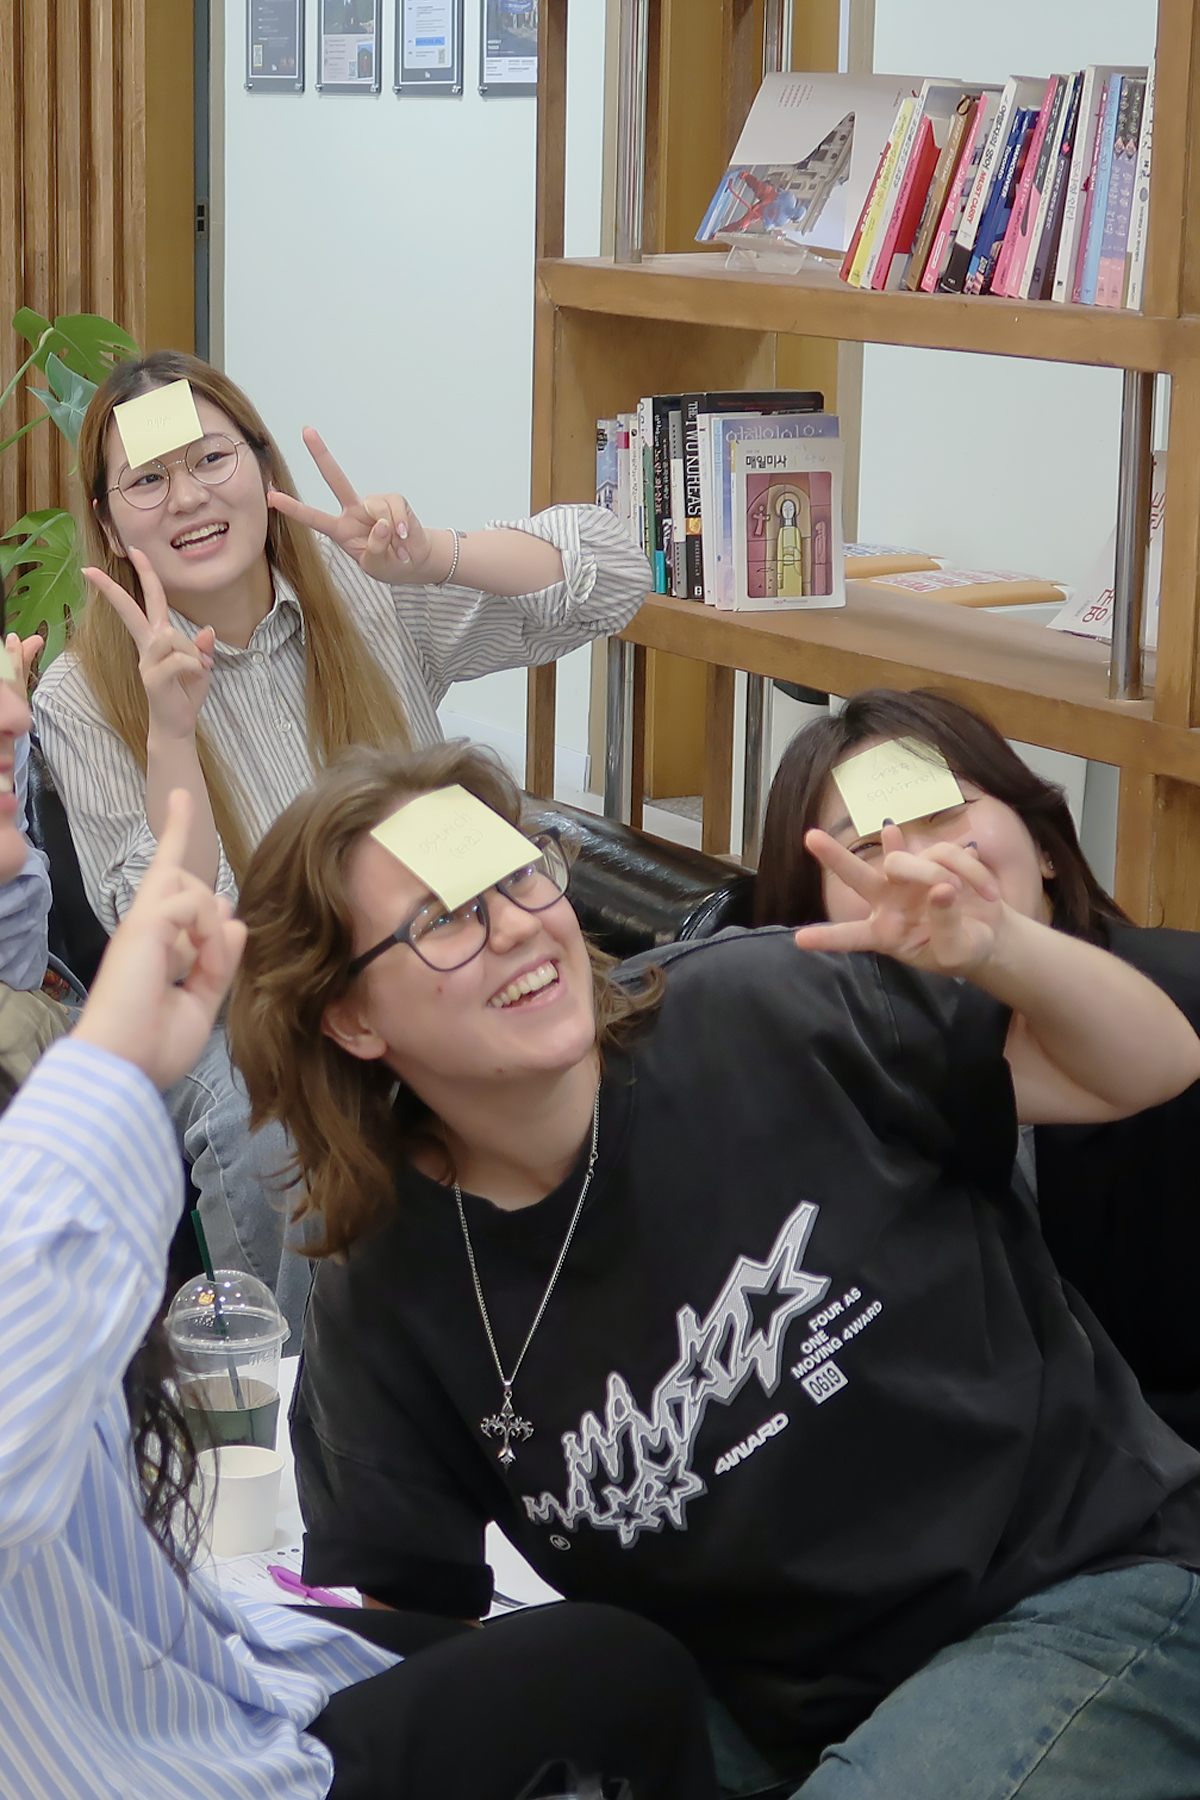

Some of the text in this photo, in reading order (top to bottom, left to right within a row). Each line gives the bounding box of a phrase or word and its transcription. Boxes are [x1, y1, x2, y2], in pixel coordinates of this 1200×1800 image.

[998, 146, 1012, 180] Toronto
[1001, 144, 1021, 198] VANCOUVER
[975, 171, 987, 196] MUST
[967, 198, 979, 224] CARRY
[687, 401, 698, 418] THE
[746, 455, 787, 469] 매일미사
[686, 454, 702, 516] KOREAS
[866, 769, 938, 803] squirrel
[808, 1286, 862, 1332] FOUR AS
[791, 1300, 883, 1379] MOVING 4WARD
[801, 1330, 830, 1355] ONE
[808, 1367, 843, 1398] 0619
[714, 1412, 790, 1475] 4WARD
